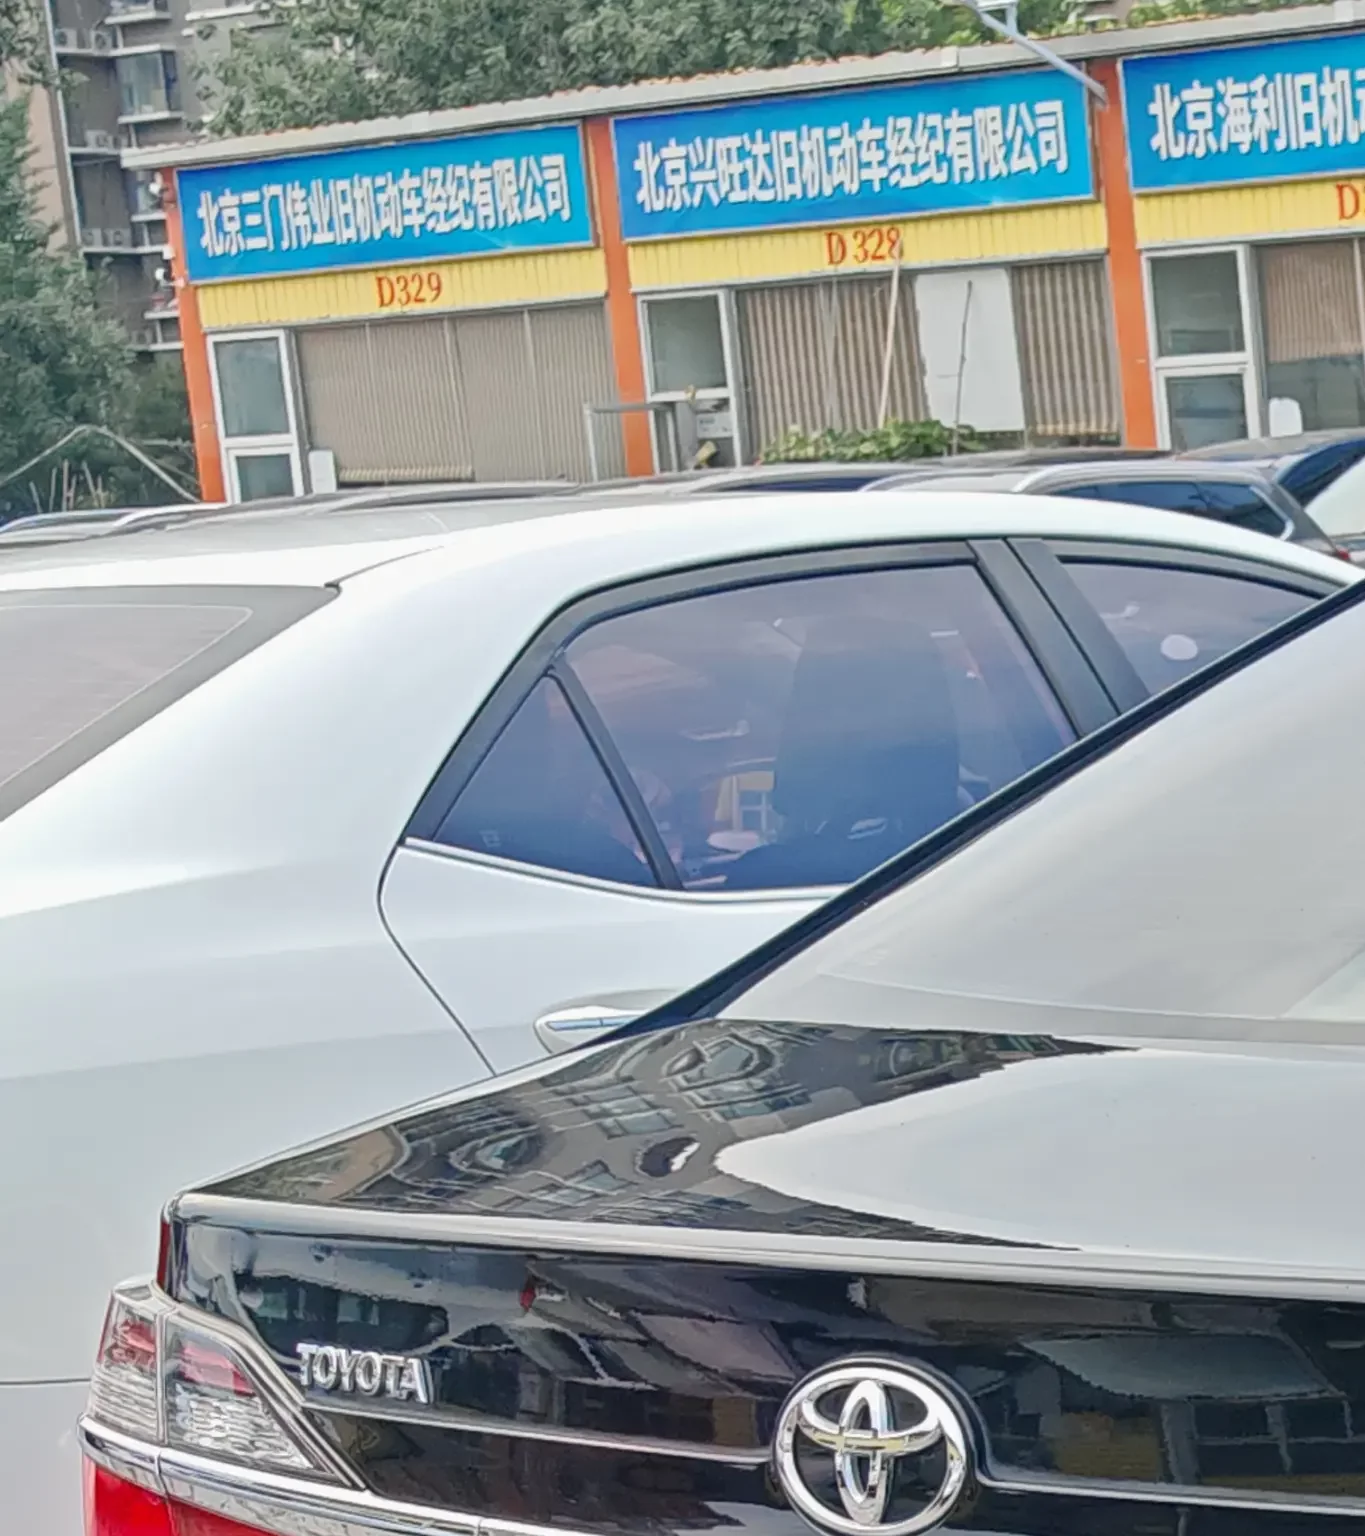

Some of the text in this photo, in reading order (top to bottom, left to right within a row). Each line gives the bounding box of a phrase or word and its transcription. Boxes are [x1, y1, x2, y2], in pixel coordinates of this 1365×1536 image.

[633, 100, 1069, 212] 北京兴旺达旧机动车经纪有限公司
[197, 154, 572, 258] 北京三门伟业旧机动车经纪有限公司
[375, 272, 443, 308] D329
[296, 1343, 432, 1404] TOYOTA
